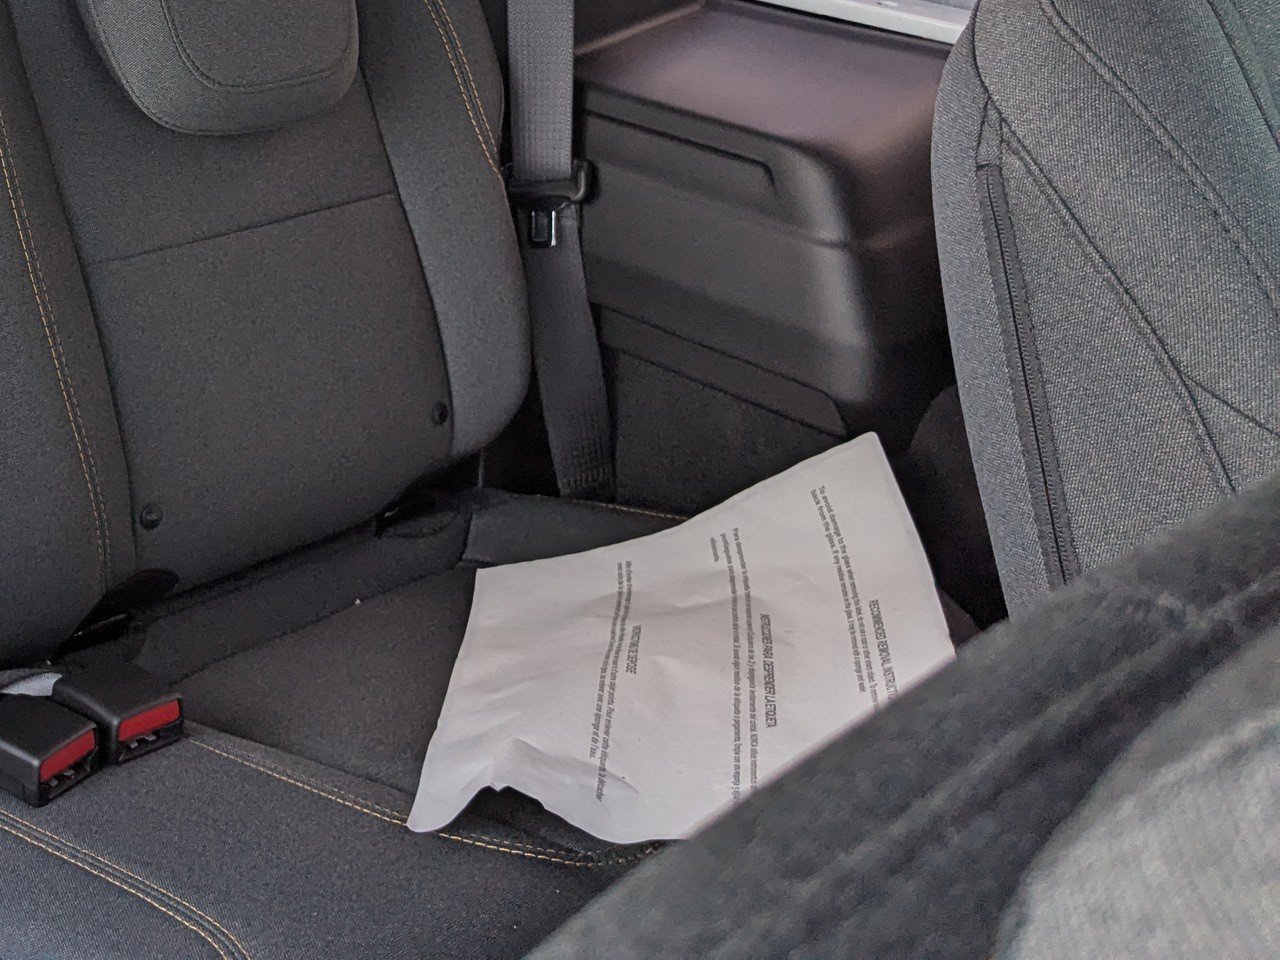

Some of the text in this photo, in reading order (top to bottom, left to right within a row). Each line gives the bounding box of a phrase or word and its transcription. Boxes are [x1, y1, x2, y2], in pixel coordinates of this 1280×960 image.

[829, 514, 841, 537] damage
[825, 532, 835, 549] glass.
[877, 640, 890, 666] REMOVAL
